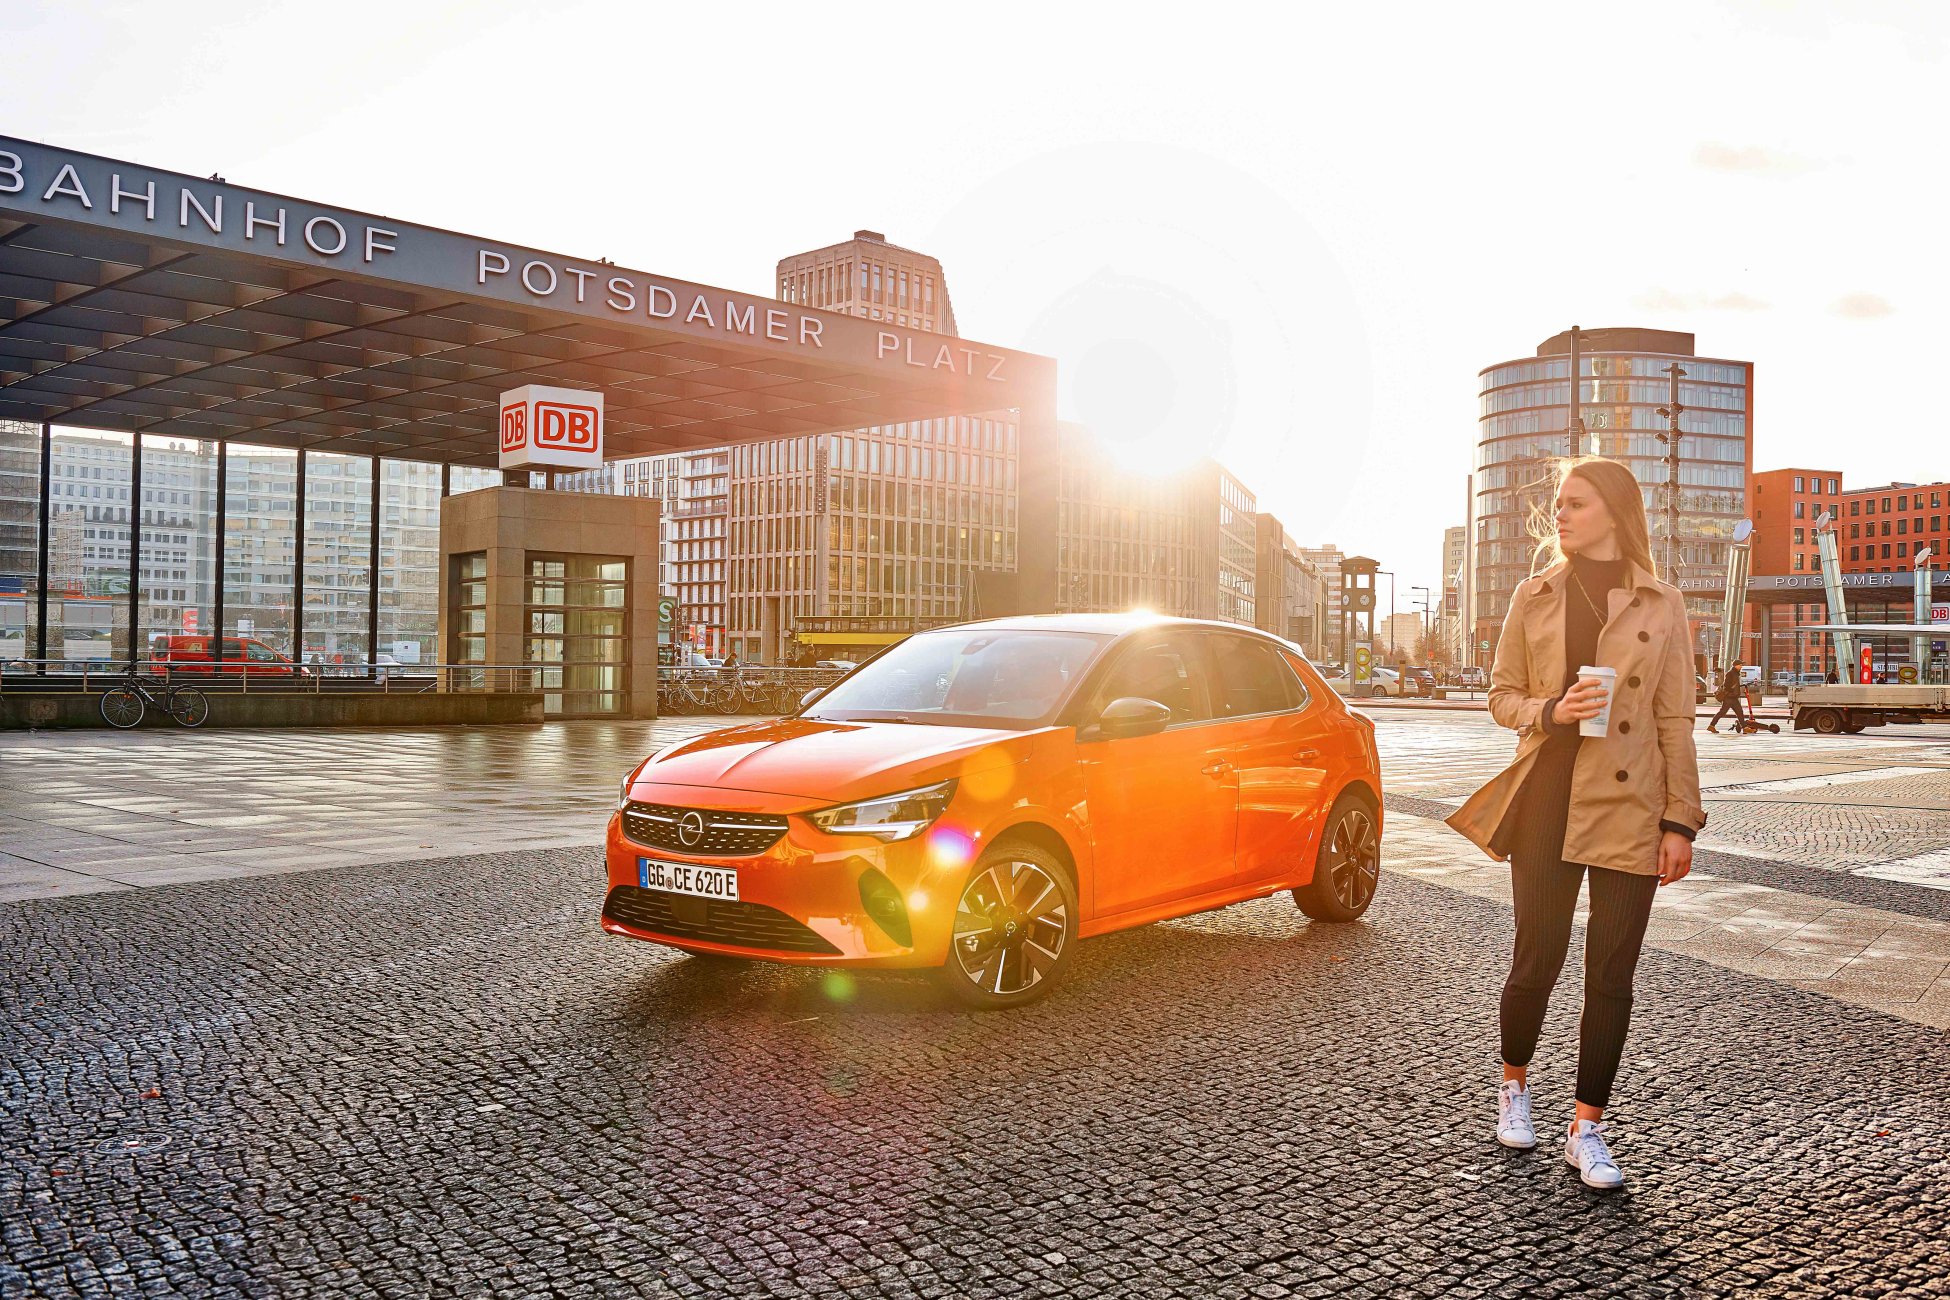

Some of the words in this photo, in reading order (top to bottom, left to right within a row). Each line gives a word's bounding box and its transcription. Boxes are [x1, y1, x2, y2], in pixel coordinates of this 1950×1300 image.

[0, 150, 398, 263] BAHNHOF
[478, 249, 823, 348] POTSDAMER
[877, 330, 1007, 382] PLATZ
[504, 410, 524, 444] DB
[543, 409, 590, 444] DB
[1775, 574, 1894, 587] POTSAMER
[659, 602, 673, 623] S
[1931, 609, 1947, 619] DB
[647, 863, 665, 887] GG
[674, 867, 692, 892] CE
